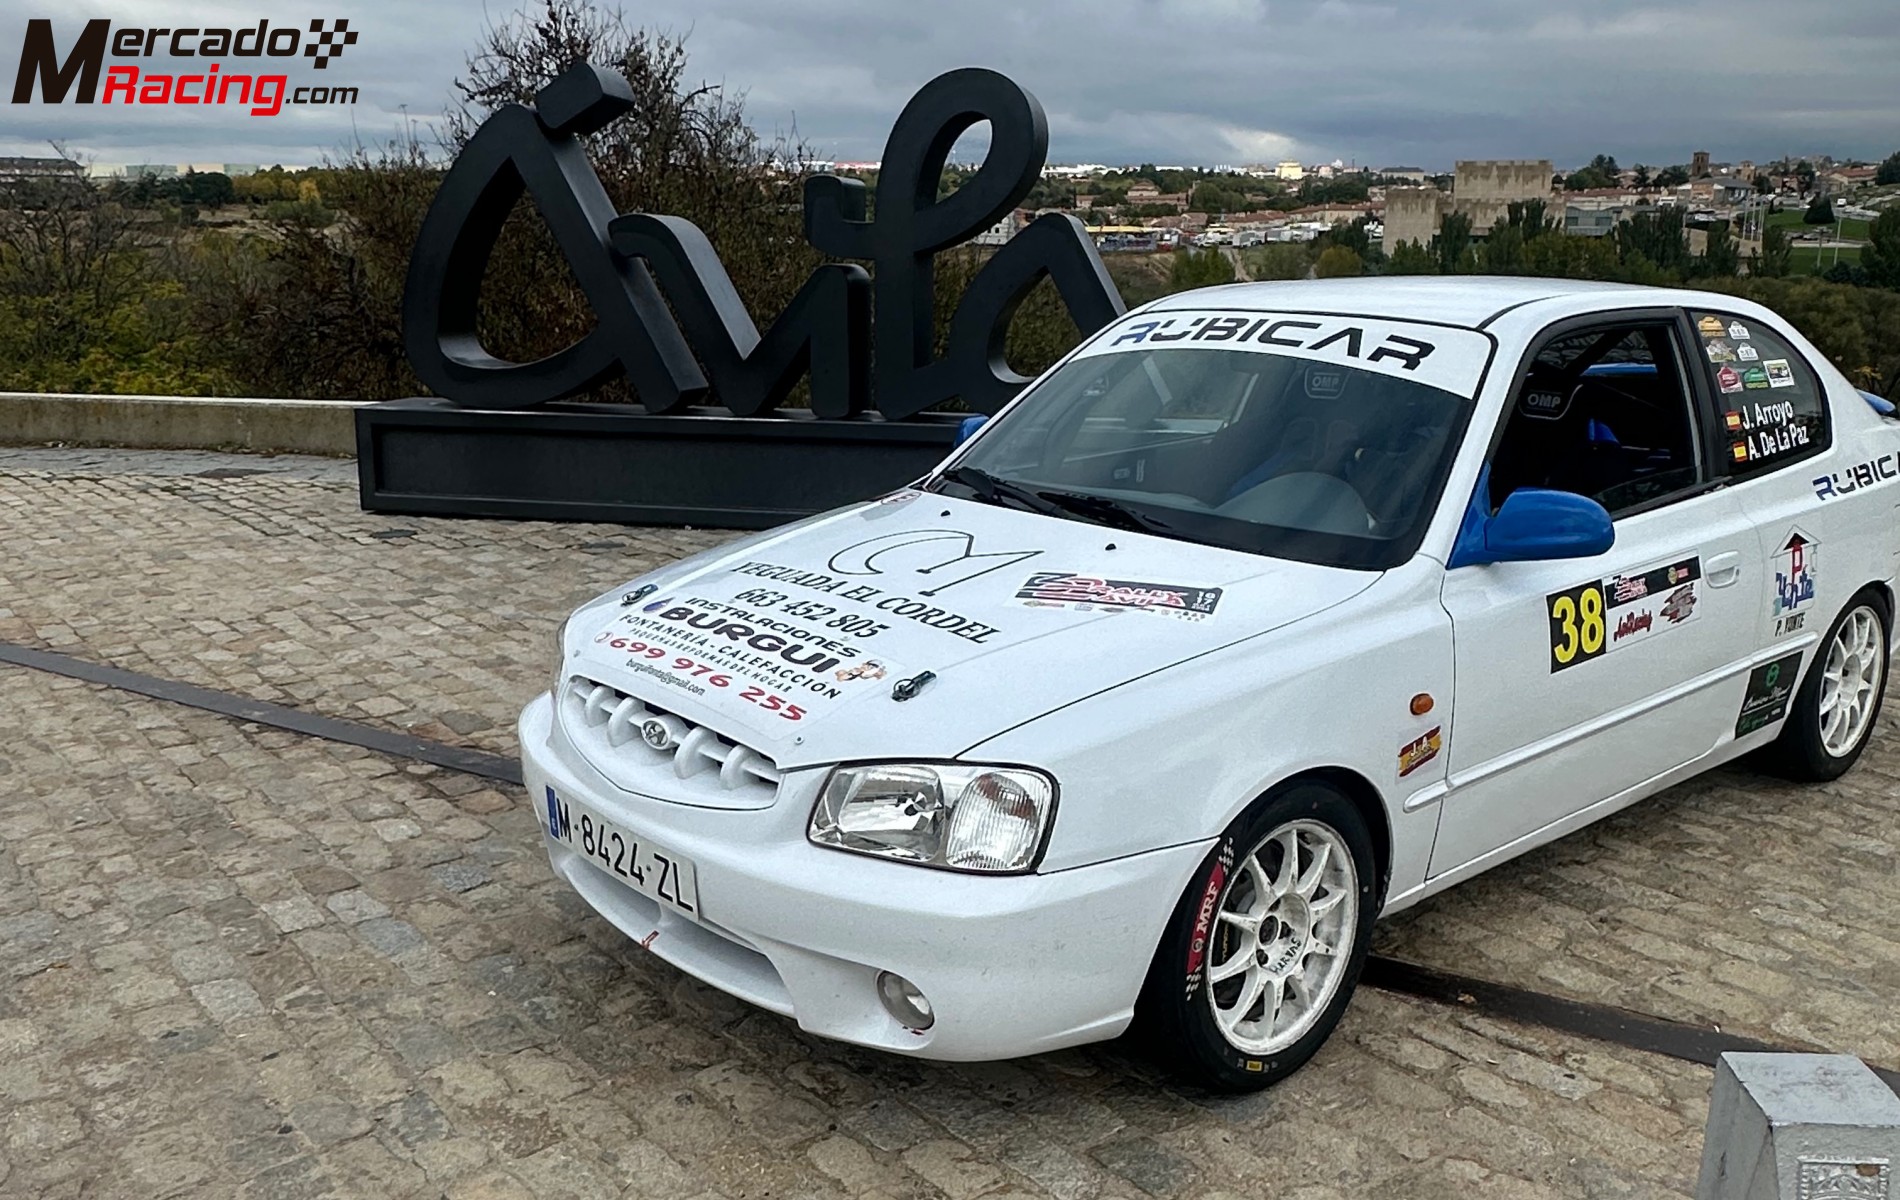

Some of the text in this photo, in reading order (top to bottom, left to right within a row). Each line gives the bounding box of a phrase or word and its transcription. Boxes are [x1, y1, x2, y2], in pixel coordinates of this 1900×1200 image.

[1110, 317, 1436, 371] RUBICAR
[1312, 375, 1340, 388] OMP
[1527, 393, 1561, 408] OMP
[1742, 400, 1794, 430] J. Arroyo
[1759, 431, 1777, 456] De
[1774, 427, 1791, 451] La
[1788, 423, 1810, 448] Paz
[1812, 451, 1900, 501] RUBIC
[729, 561, 1001, 644] YEGUADA EL CORDEL
[734, 587, 891, 638] 663 452 805
[1552, 587, 1605, 664] 38
[659, 607, 841, 673] BURGUI
[610, 638, 808, 721] 699 976 255
[718, 645, 842, 700] CALEFACCIÓN
[1197, 881, 1219, 934] MRF
